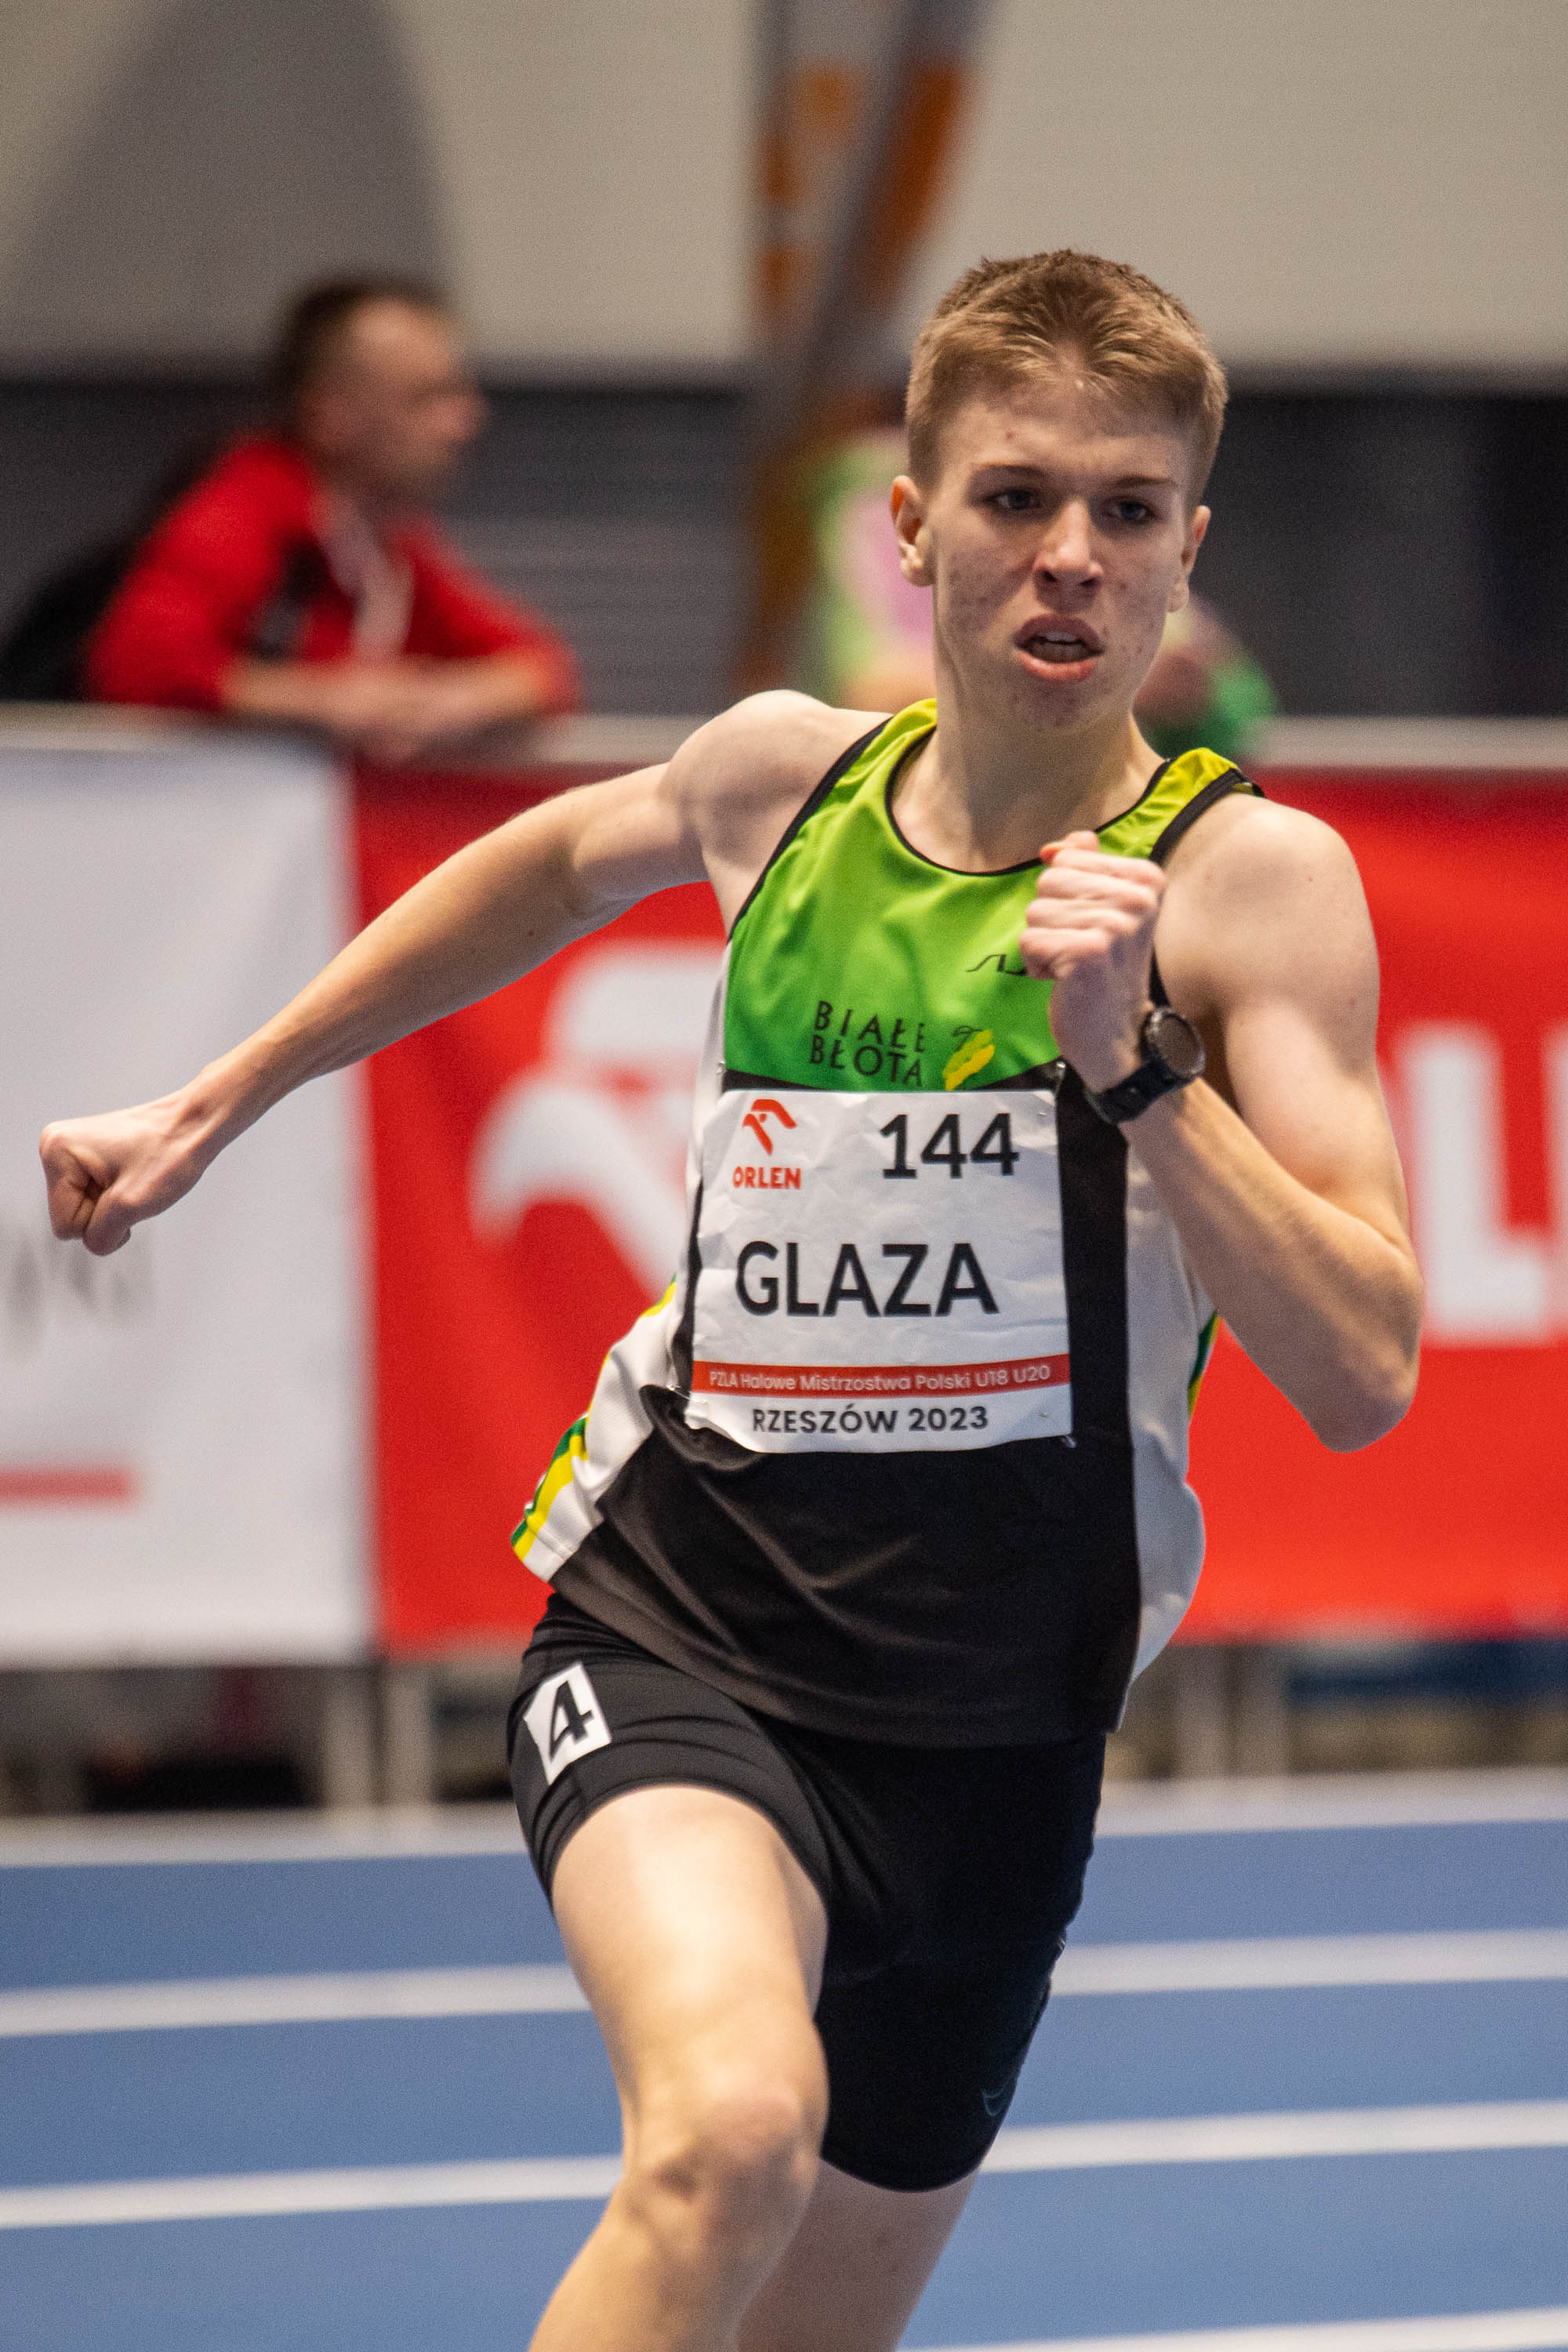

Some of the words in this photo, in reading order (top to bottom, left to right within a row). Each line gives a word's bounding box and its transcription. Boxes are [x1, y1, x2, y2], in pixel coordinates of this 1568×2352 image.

[814, 1000, 926, 1053] BIAŁE
[810, 1033, 923, 1087] BŁOTA
[880, 1112, 1019, 1179] 144
[732, 1166, 801, 1189] ORLEN
[735, 1240, 1000, 1318] GLAZA
[709, 1370, 738, 1388] PZLA
[741, 1373, 796, 1391] Halowe
[799, 1374, 911, 1392] Mistrzostwa
[915, 1373, 971, 1390] Polski
[975, 1370, 1009, 1388] U18
[1013, 1364, 1051, 1383] U20
[752, 1403, 899, 1434] RZESZÓW
[907, 1406, 989, 1432] 2023
[549, 1679, 595, 1763] 4
